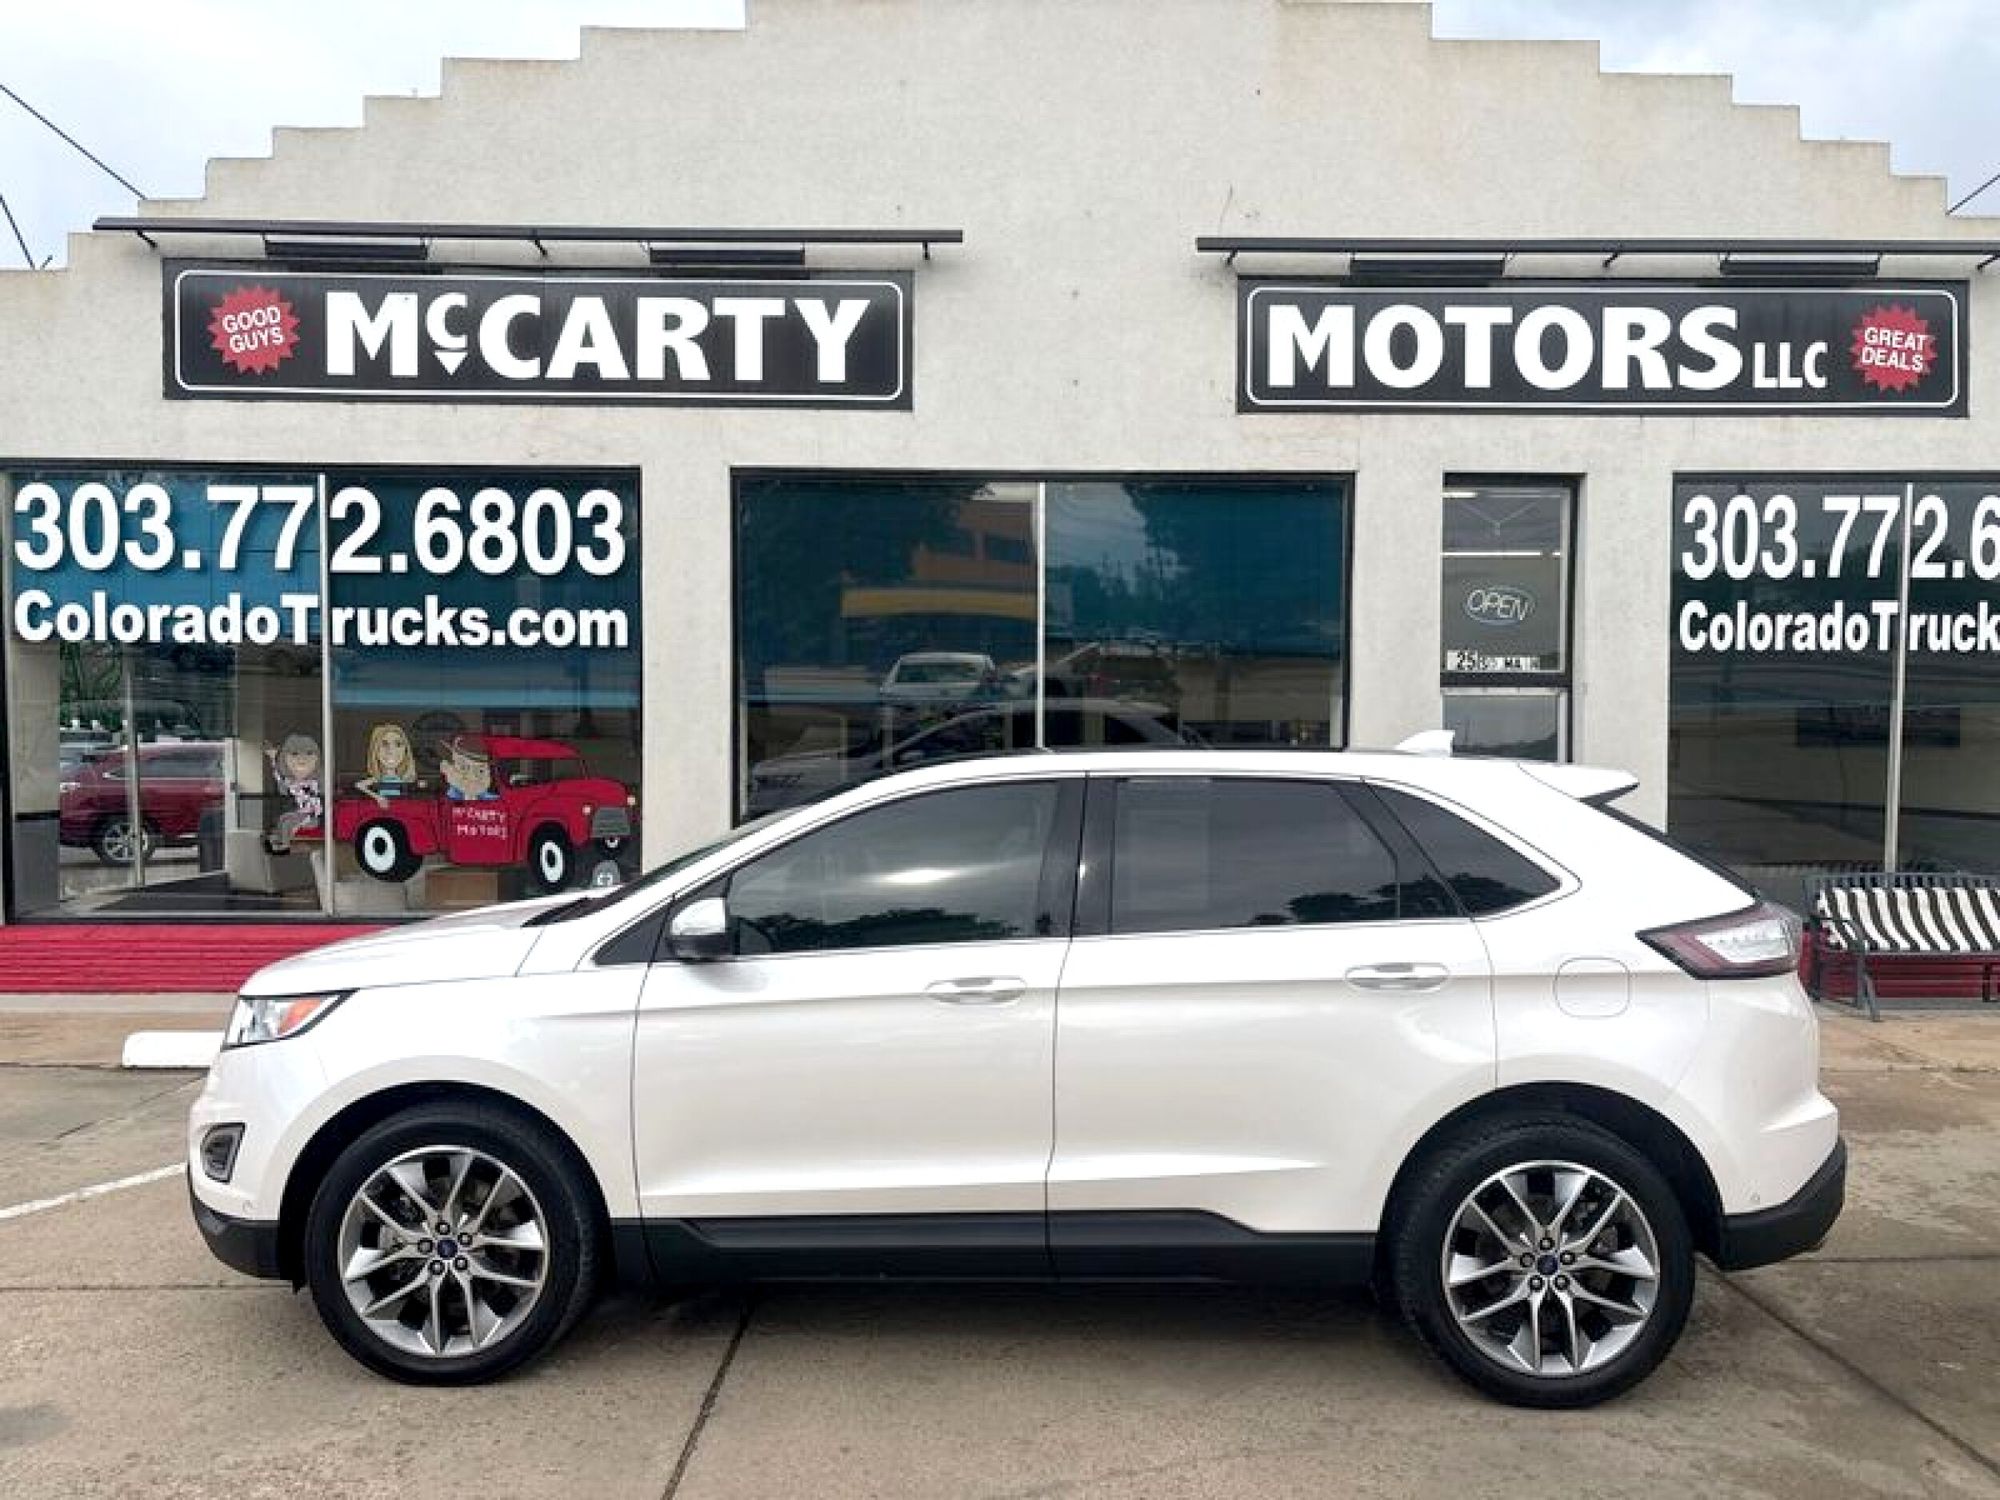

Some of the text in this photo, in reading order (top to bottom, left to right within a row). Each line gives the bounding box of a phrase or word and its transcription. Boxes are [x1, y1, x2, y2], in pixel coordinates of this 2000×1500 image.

[222, 305, 281, 333] GOOD
[229, 326, 285, 353] GUYS
[1267, 304, 1828, 390] MOTORS LLC
[1864, 326, 1928, 351] GREAT
[1861, 347, 1924, 373] DEALS
[14, 483, 626, 576] 303.772.6803
[14, 589, 629, 648] ColoradoTrucks.com
[1467, 589, 1529, 621] OPEN
